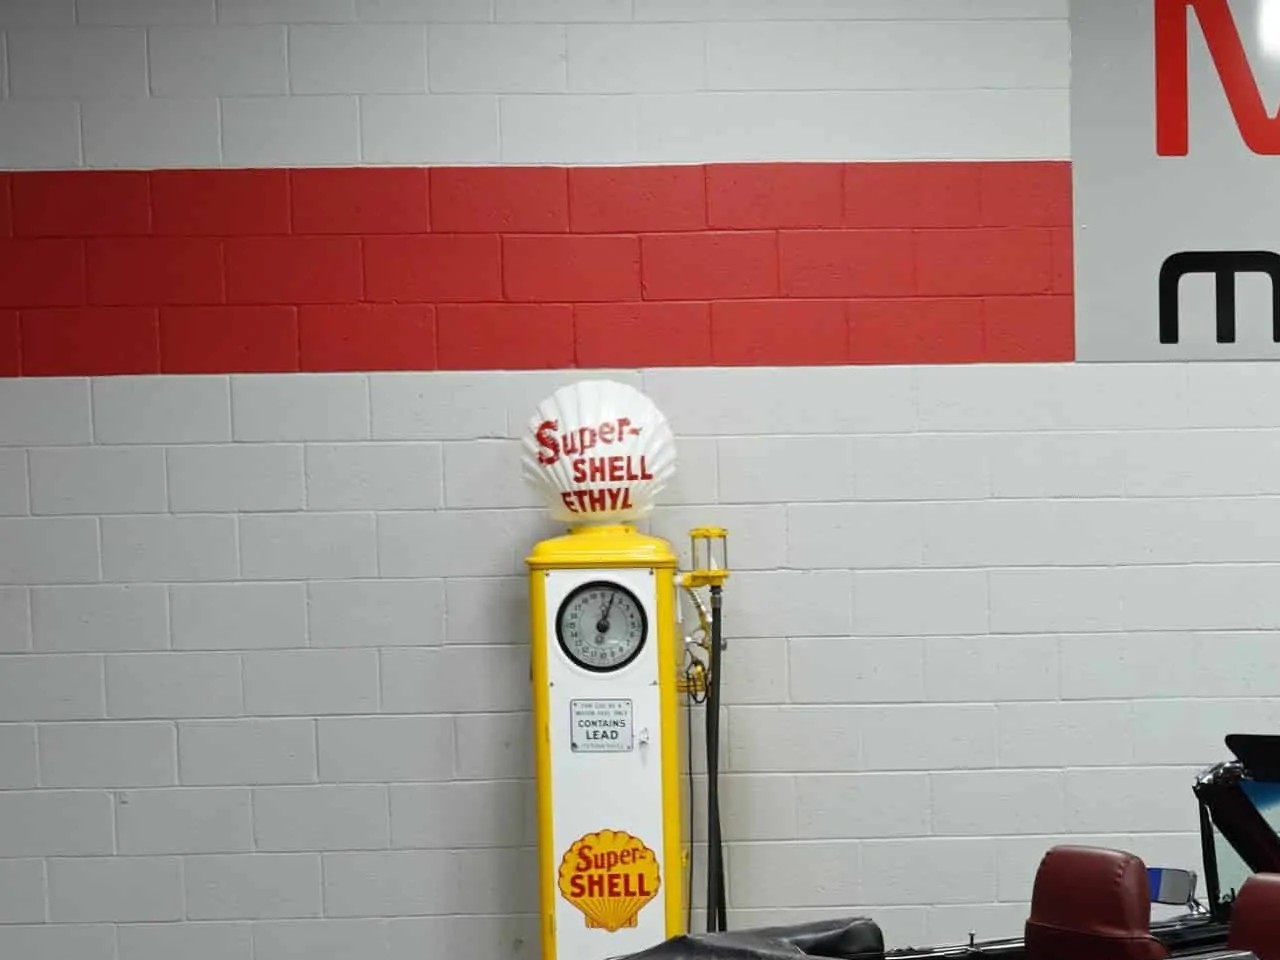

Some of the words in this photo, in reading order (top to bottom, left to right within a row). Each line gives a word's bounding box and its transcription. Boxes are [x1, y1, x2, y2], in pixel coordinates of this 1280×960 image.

[536, 416, 643, 466] Super-
[572, 455, 654, 484] SHELL
[560, 487, 633, 513] ETHYL
[577, 719, 626, 728] CONTAINS
[585, 729, 619, 740] LEAD
[575, 844, 647, 873] Super-
[570, 873, 651, 898] SHELL
